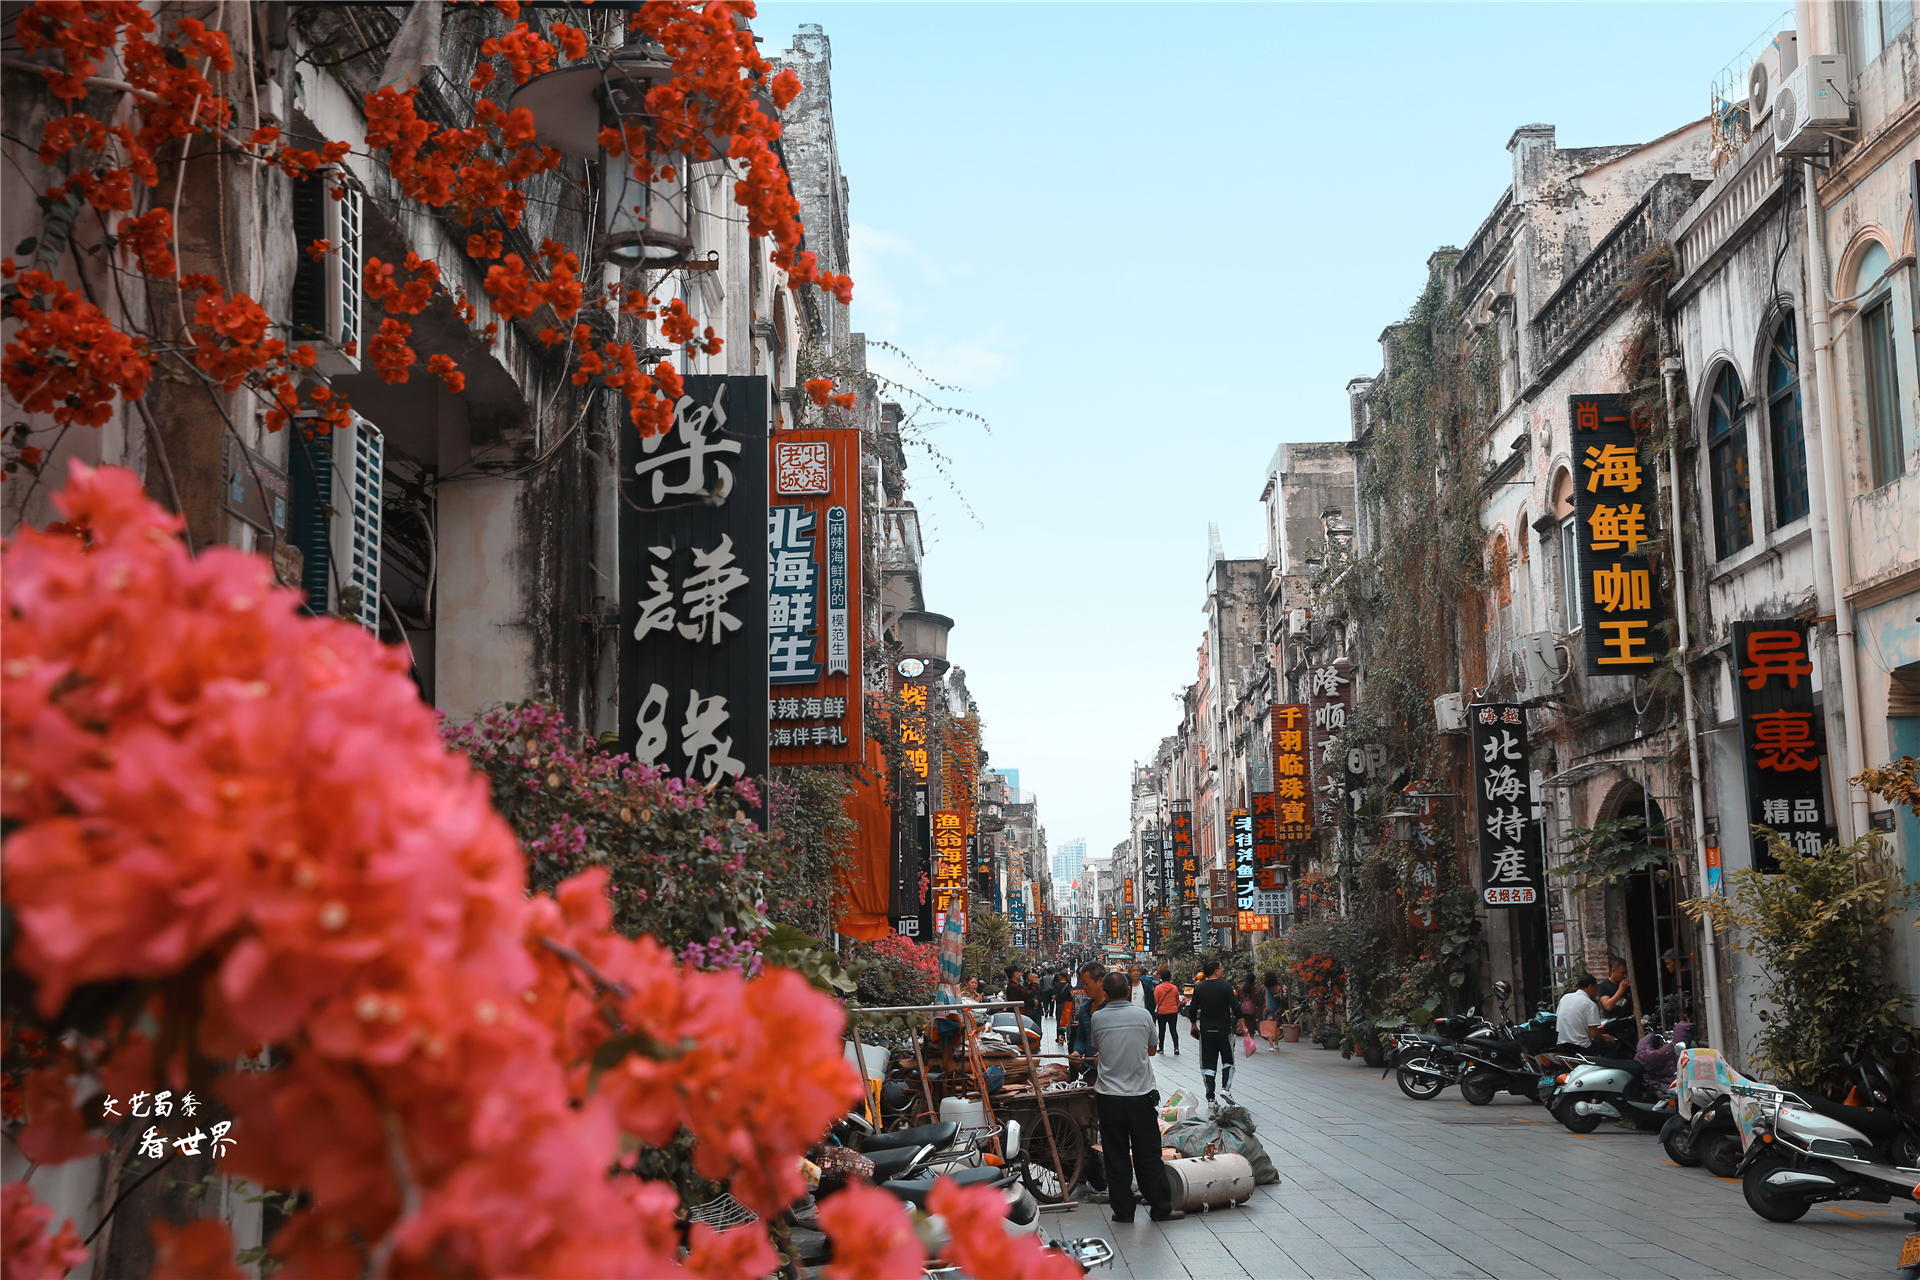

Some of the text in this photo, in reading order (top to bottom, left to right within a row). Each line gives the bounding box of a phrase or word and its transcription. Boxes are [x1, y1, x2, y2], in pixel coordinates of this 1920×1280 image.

[1583, 444, 1654, 664] 海鲜咖王
[831, 523, 845, 655] 麻辣海鲜界的 模范生
[769, 726, 848, 746] 海伴手礼
[1764, 799, 1818, 824] 精品
[1488, 889, 1533, 902] 名烟名酒
